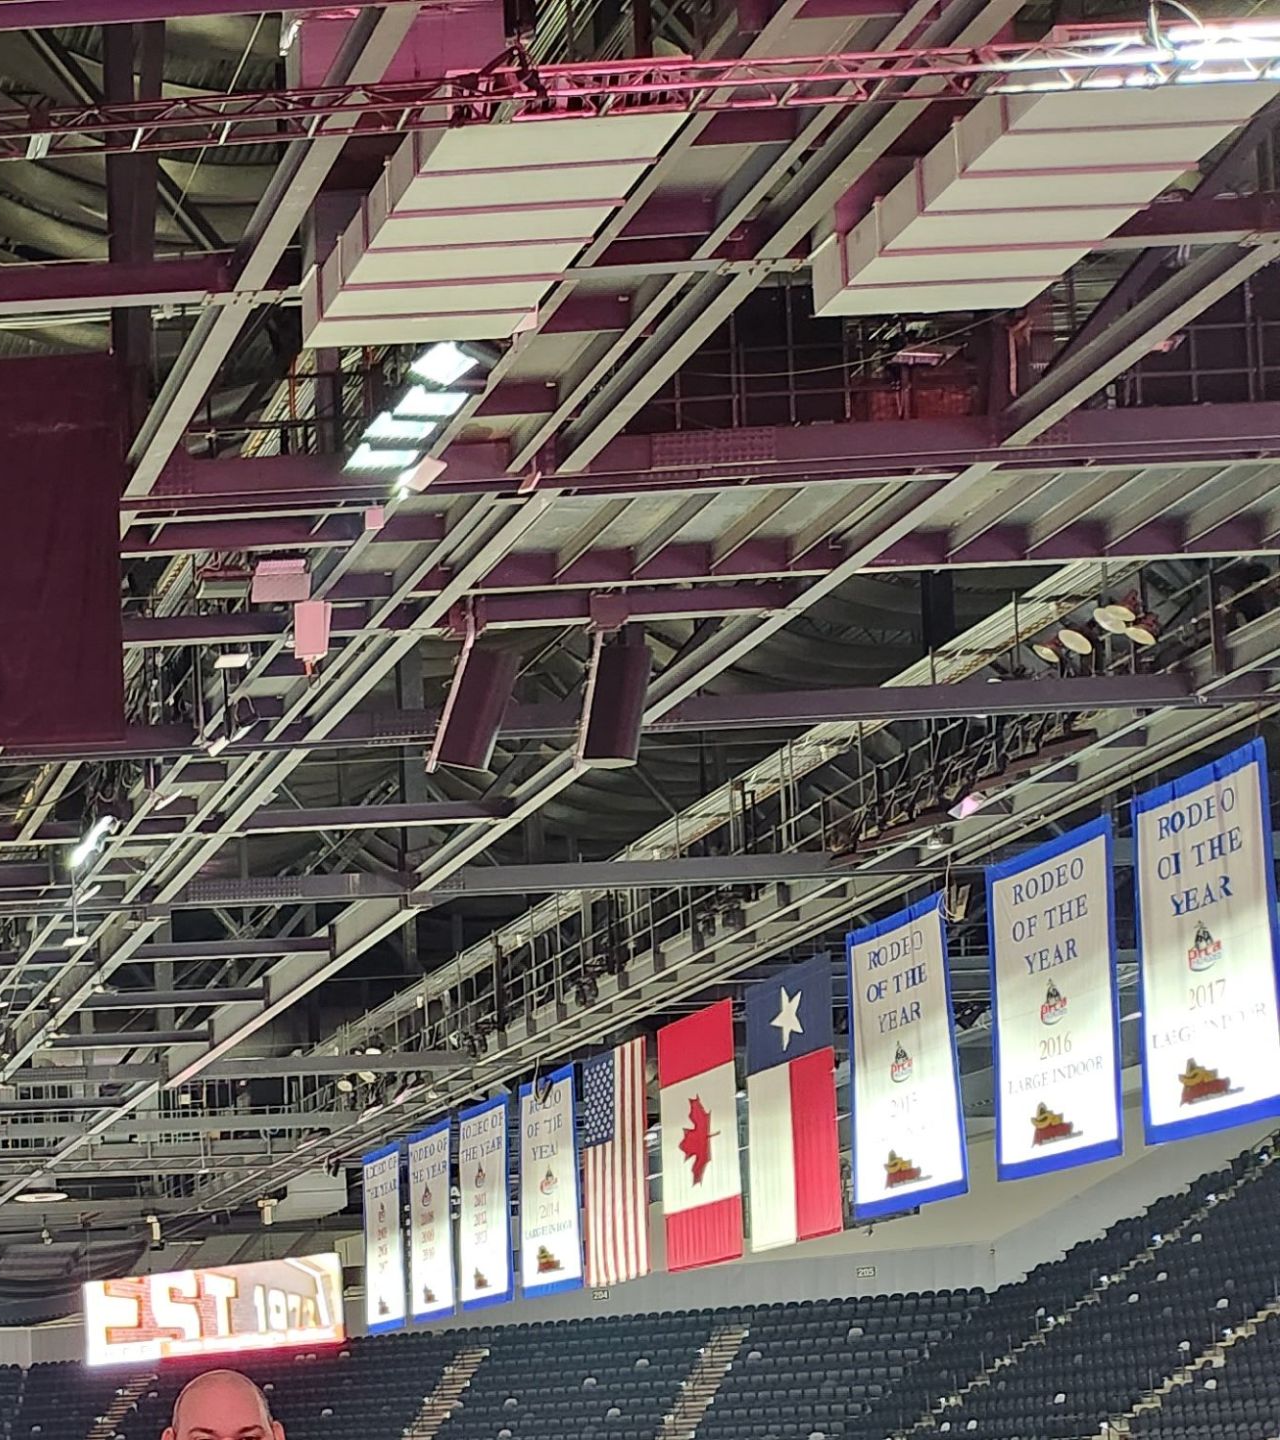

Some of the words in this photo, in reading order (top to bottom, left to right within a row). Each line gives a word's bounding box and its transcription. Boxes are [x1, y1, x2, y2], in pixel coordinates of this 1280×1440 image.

[1157, 787, 1236, 841] RODEO
[1191, 826, 1243, 867] THE
[1012, 856, 1085, 906] RODEO
[1169, 875, 1233, 917] YEAR
[1012, 915, 1038, 943] OF
[1043, 893, 1089, 930] THE
[867, 930, 923, 972] RODEO
[1024, 937, 1078, 976] YEAR
[866, 979, 888, 1004] OF
[893, 962, 928, 995] THE
[1188, 977, 1227, 1011] 2017
[877, 1001, 922, 1035] YEAR
[1039, 1031, 1072, 1061] 2016
[526, 1121, 540, 1140] OF
[84, 1270, 239, 1350] EST
